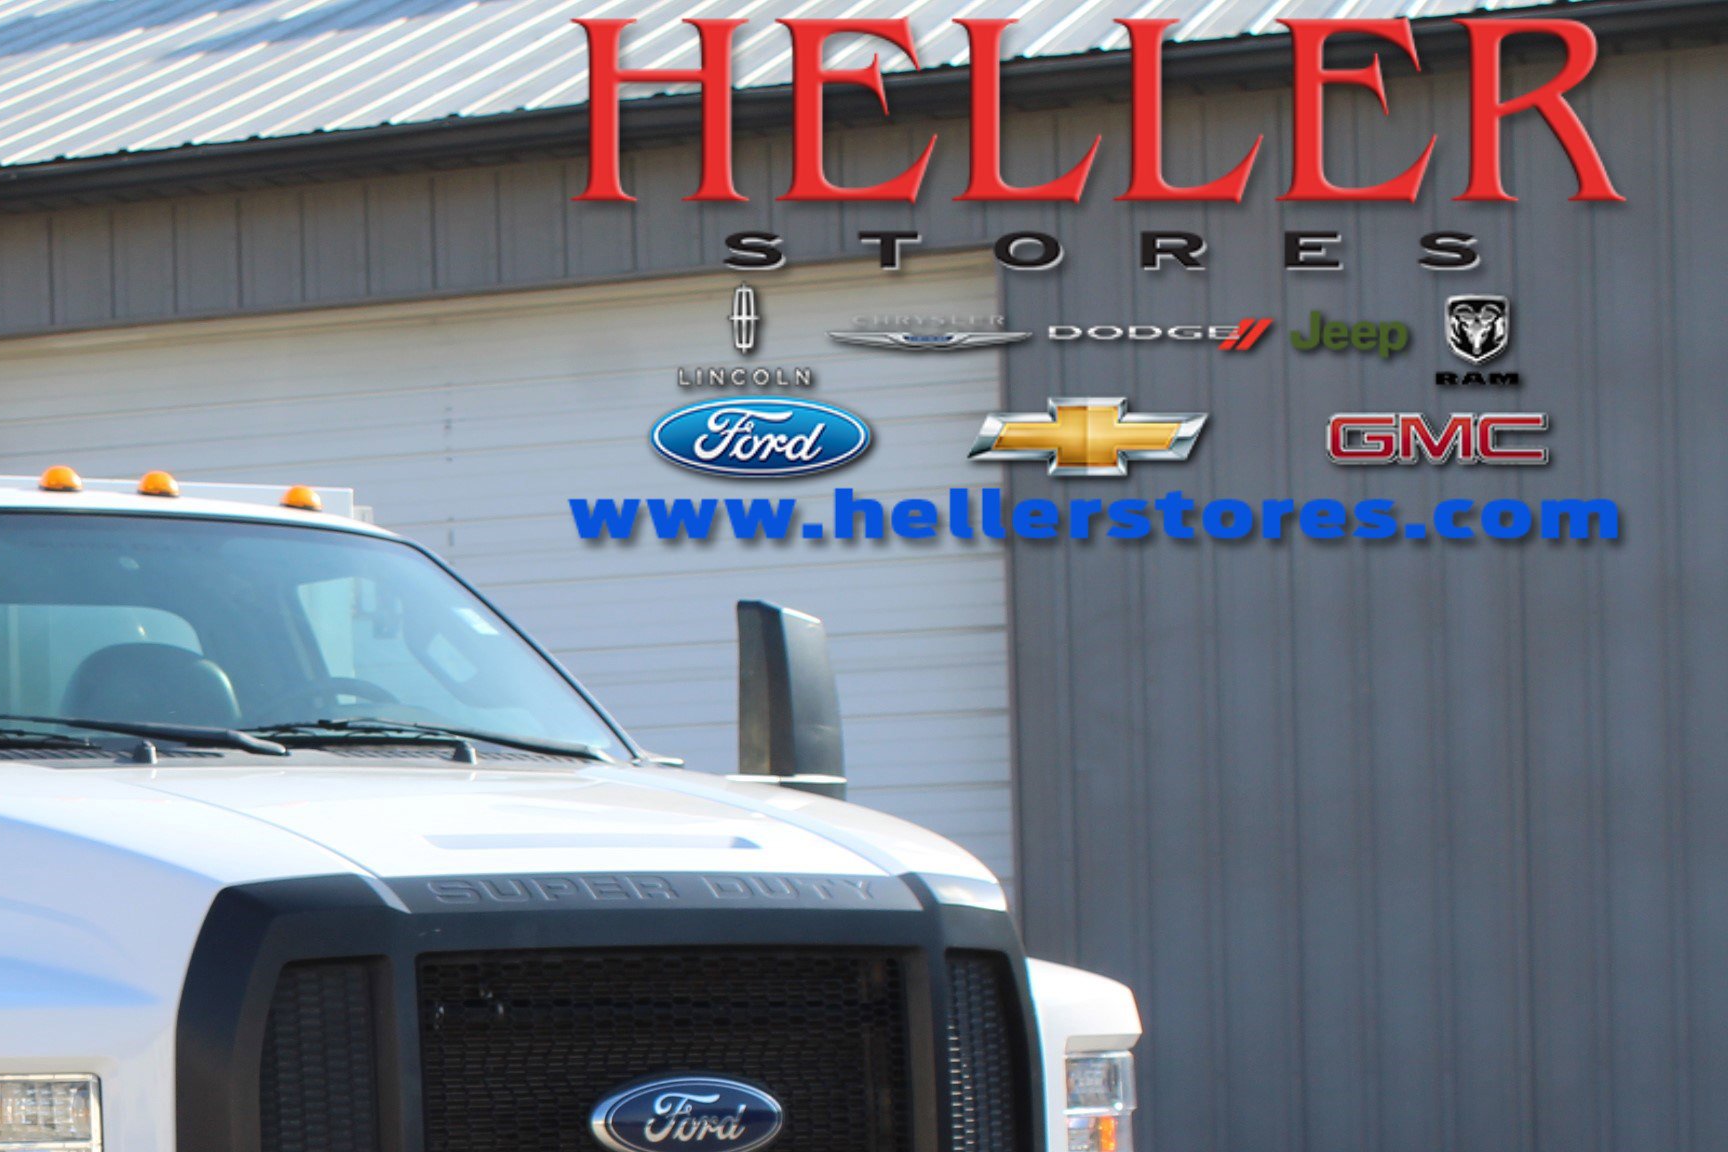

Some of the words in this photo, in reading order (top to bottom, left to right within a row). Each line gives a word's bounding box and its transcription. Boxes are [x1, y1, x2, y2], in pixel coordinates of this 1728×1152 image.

[427, 874, 679, 903] SUPER
[699, 874, 877, 901] DUTY
[644, 1092, 747, 1143] Ford
